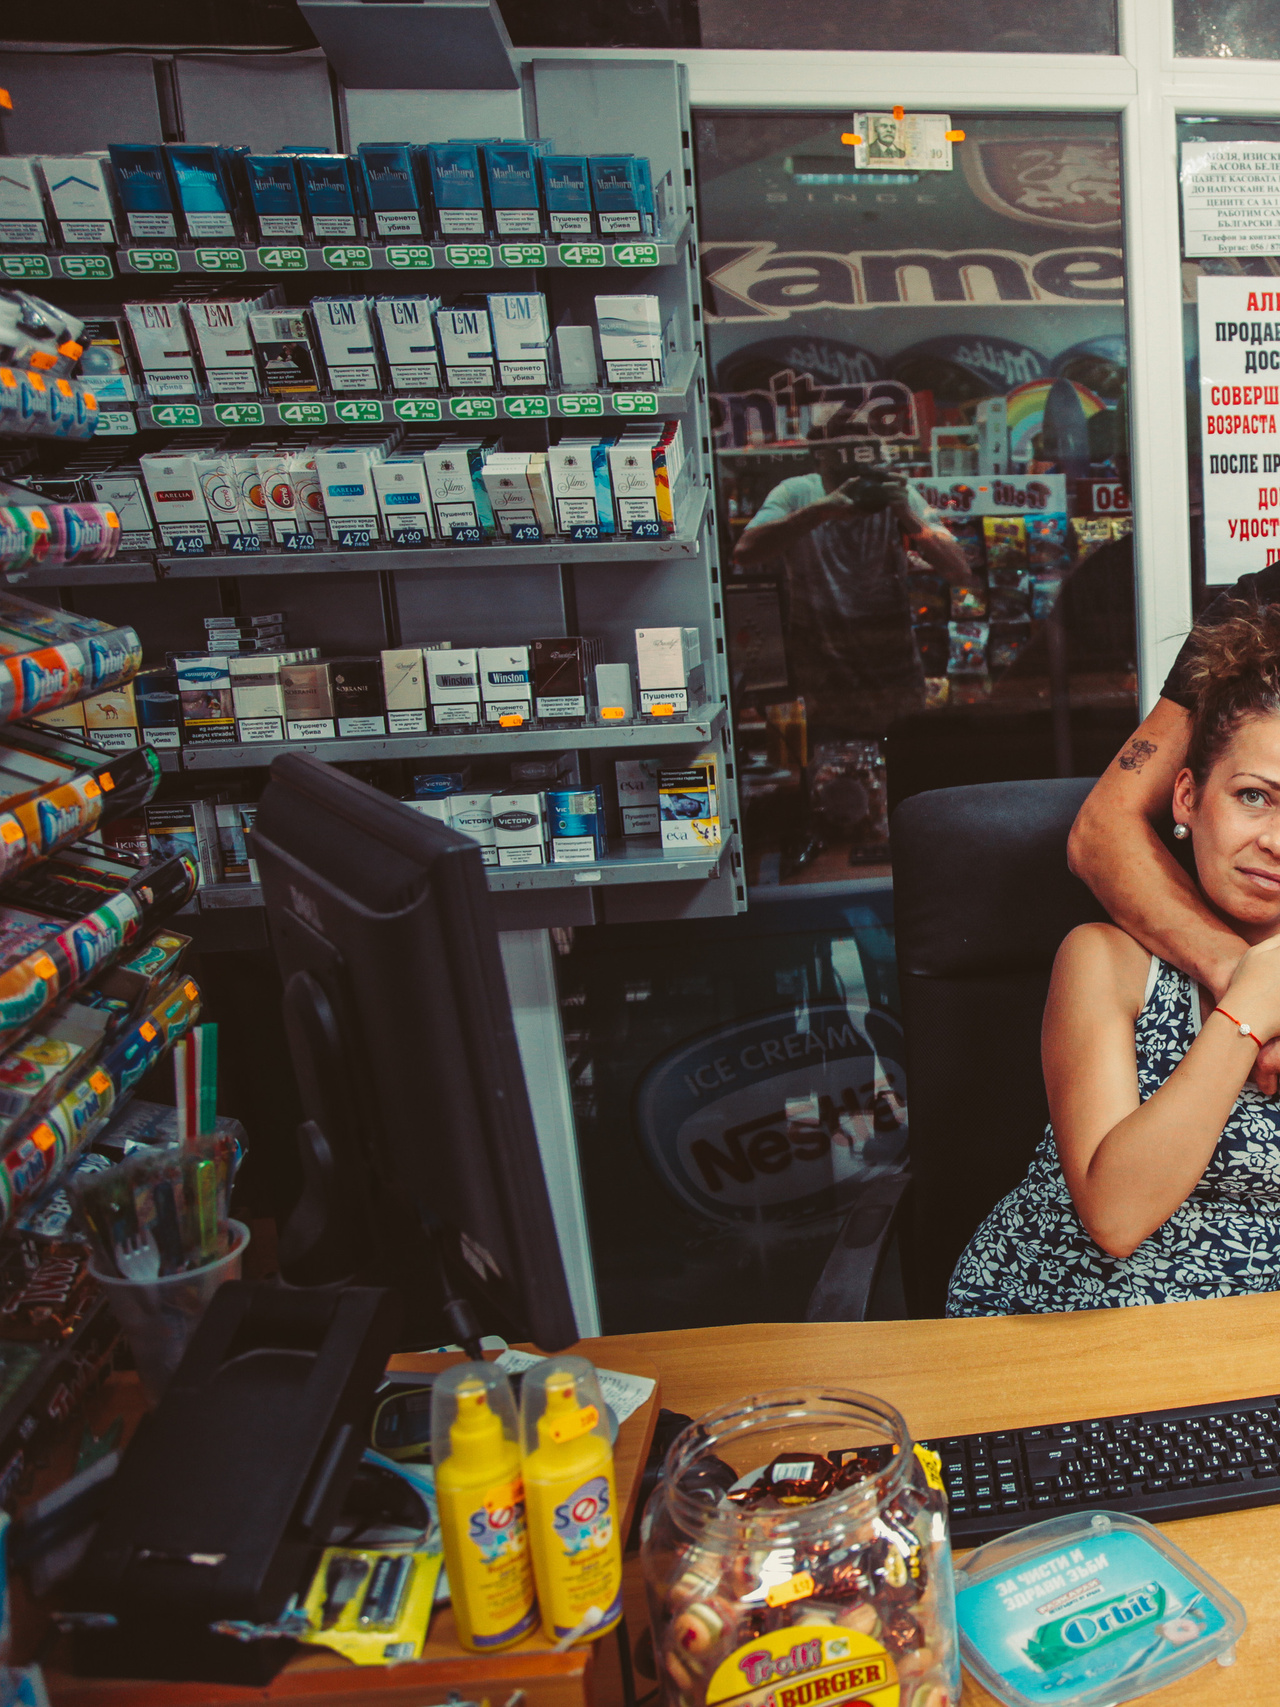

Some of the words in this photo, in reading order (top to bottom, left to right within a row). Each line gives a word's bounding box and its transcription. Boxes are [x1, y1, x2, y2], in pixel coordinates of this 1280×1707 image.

[1210, 163, 1252, 171] КАСОВА
[1229, 175, 1276, 183] КАСОВАТА
[1192, 186, 1205, 194] ДО
[1206, 199, 1243, 207] ЦЕНИТЕ
[378, 215, 417, 223] Пушенето
[552, 215, 588, 223] Пушенето
[601, 215, 637, 223] Пушенето
[560, 222, 582, 230] убива
[609, 222, 631, 230] убива
[1218, 220, 1272, 228] БЪЛГАРСКИ
[503, 365, 541, 373] Пушенето
[149, 374, 189, 382] Пушенето
[512, 374, 534, 383] убива
[1207, 415, 1277, 434] ВОЗРАСТА
[1210, 454, 1258, 474] ПОСЛЕ
[158, 491, 191, 500] KARELIA
[441, 675, 474, 687] Winston
[493, 672, 524, 684] Winston
[643, 692, 684, 701] Пушенето
[294, 723, 328, 731] Пушенето
[301, 729, 321, 737] убива
[498, 817, 532, 825] VICTORY
[666, 831, 689, 841] eva
[684, 1064, 737, 1097] ICE
[740, 1024, 858, 1068] CREAM
[995, 1580, 1018, 1598] ЗА
[1018, 1556, 1071, 1586] ЧИСТИ
[1002, 1578, 1066, 1611] ЗДРАВИ
[1069, 1553, 1110, 1582] ЗЪБИ
[1061, 1594, 1155, 1647] Orbit
[740, 1638, 822, 1685] Trolli
[780, 1663, 881, 1707] BURGER
